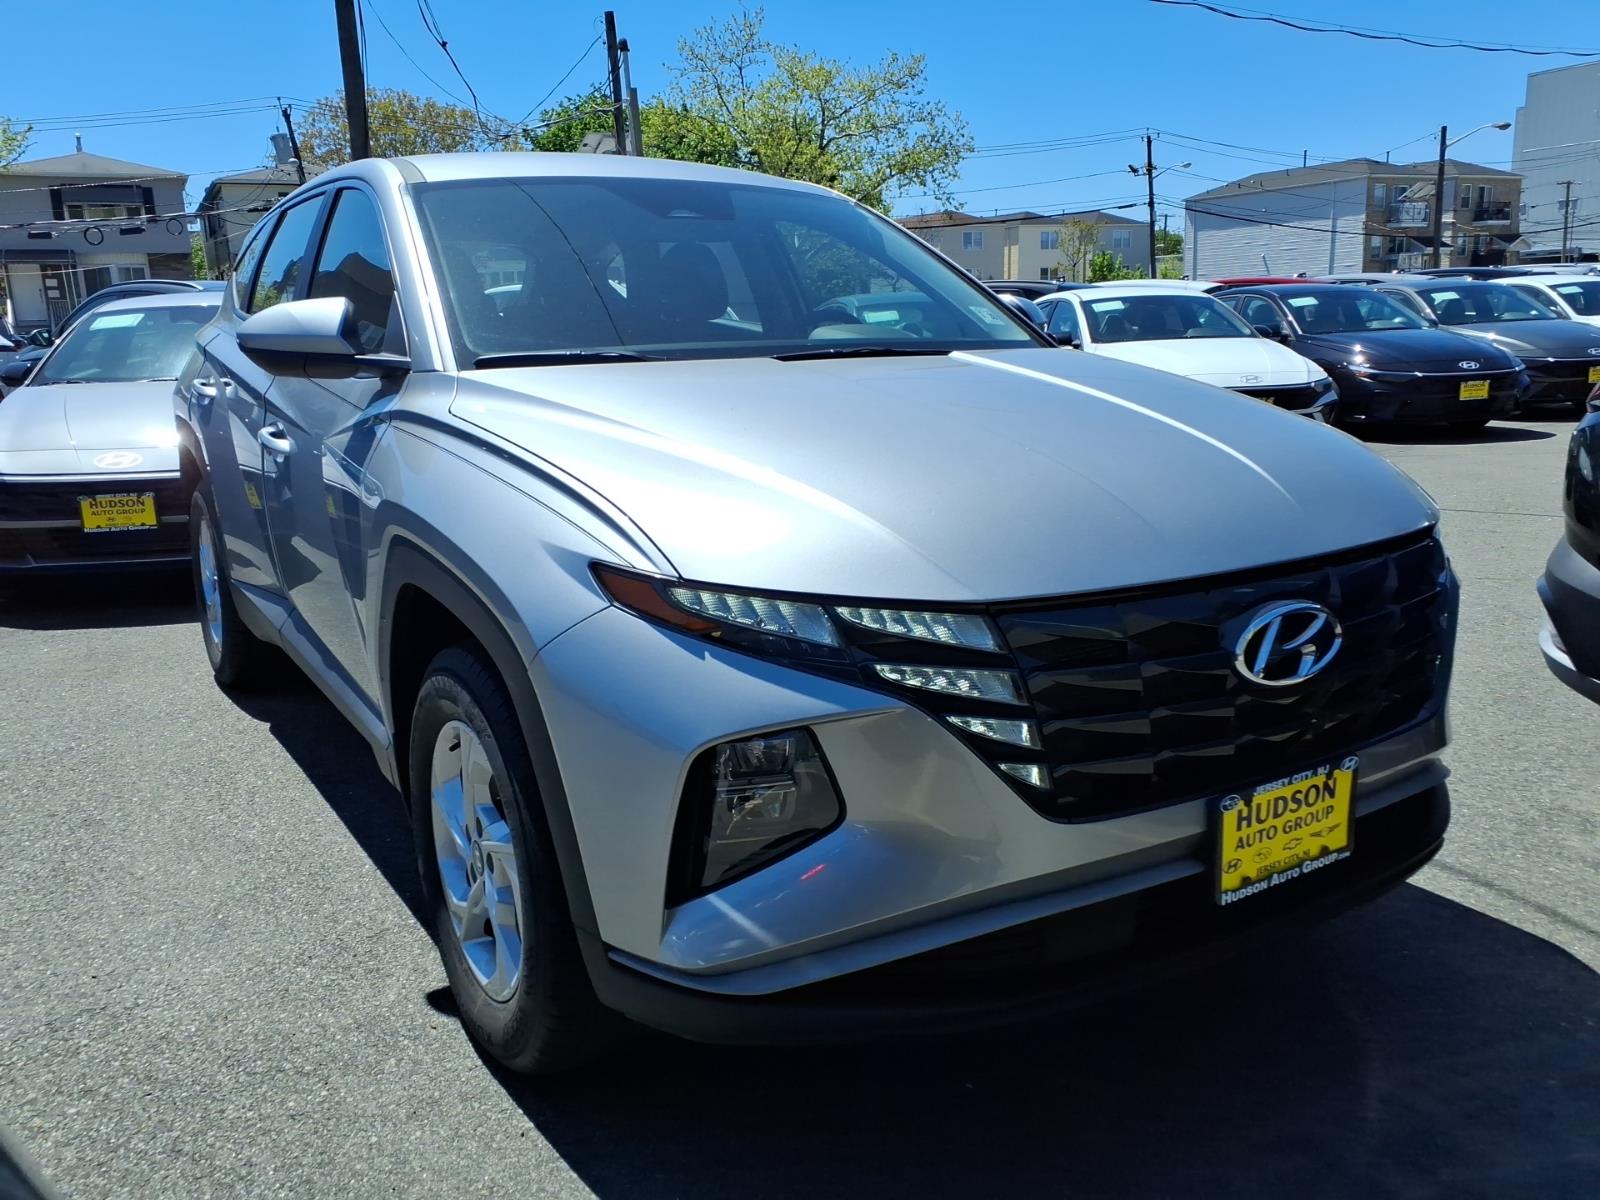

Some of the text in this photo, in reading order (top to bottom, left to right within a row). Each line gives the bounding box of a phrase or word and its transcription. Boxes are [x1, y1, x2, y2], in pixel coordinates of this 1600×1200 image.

[89, 498, 145, 509] HUDSON
[1253, 777, 1290, 796] JERSEY
[1317, 764, 1330, 775] NJ
[1236, 778, 1336, 831] HUDSON
[1236, 804, 1334, 851] AUTO GROUP
[1221, 879, 1268, 906] HUDSON
[1270, 867, 1300, 887] AUTO
